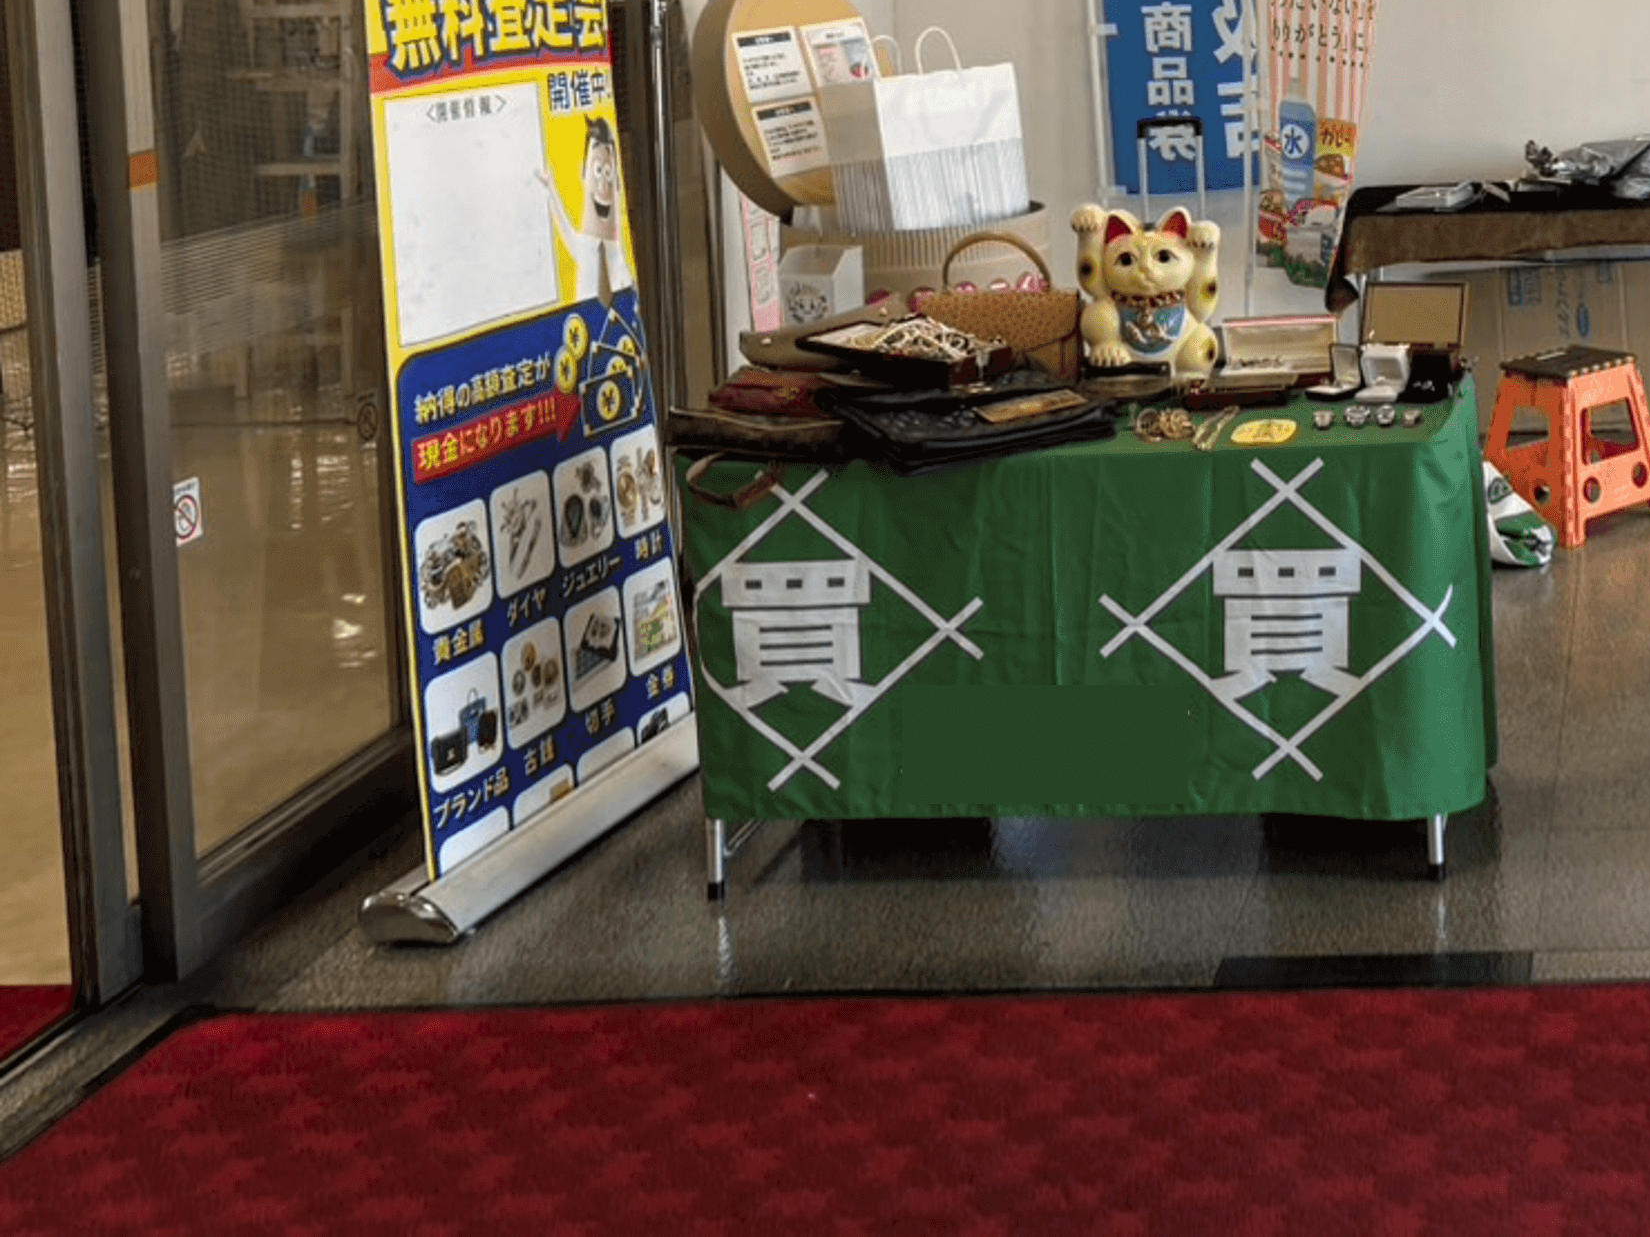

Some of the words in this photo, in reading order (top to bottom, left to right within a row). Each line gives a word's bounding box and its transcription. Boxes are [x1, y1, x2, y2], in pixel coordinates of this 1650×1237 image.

[414, 352, 551, 425] 納得の高額査定が
[433, 618, 486, 666] 貴金属
